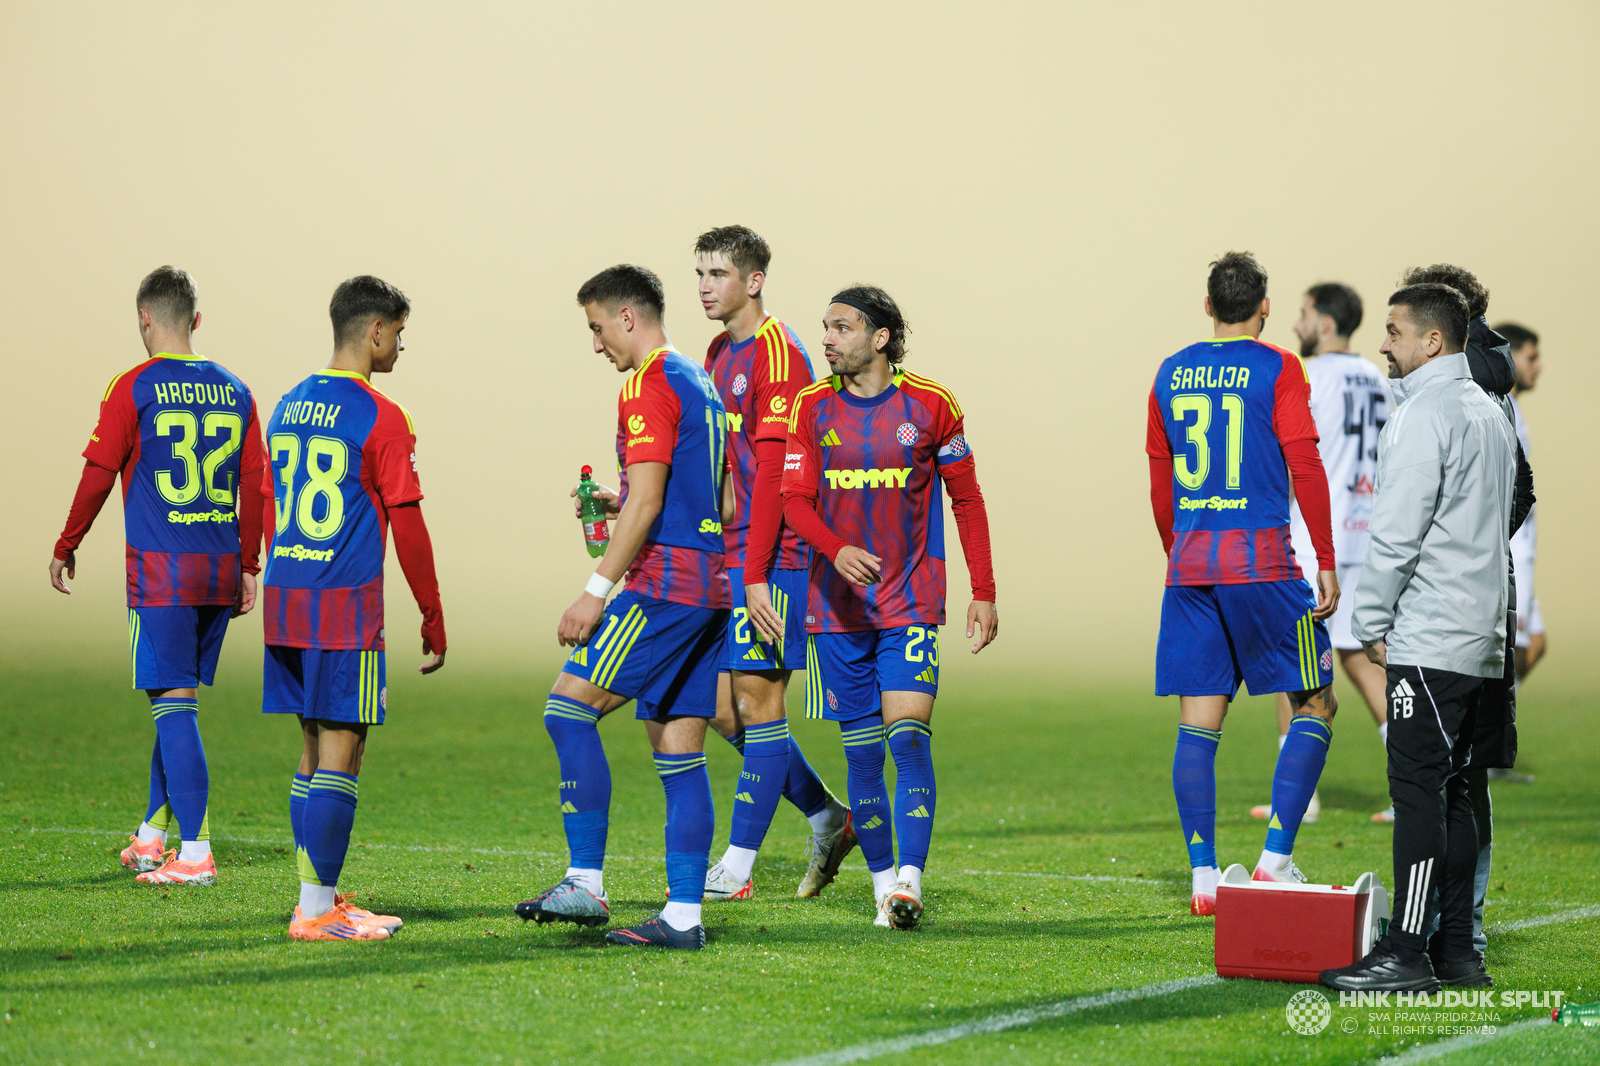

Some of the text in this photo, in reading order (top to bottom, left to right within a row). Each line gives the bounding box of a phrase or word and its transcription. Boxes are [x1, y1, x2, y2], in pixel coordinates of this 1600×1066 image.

[1170, 365, 1250, 391] ŠARLIJA
[154, 382, 237, 407] HRGOVIĆ
[281, 400, 341, 429] HODAK
[1170, 392, 1245, 491] 31
[153, 409, 243, 507] 32
[270, 432, 349, 542] 38
[824, 467, 914, 490] TOMMY
[905, 626, 940, 667] 23
[1393, 697, 1414, 720] FB
[741, 770, 761, 783] 1911
